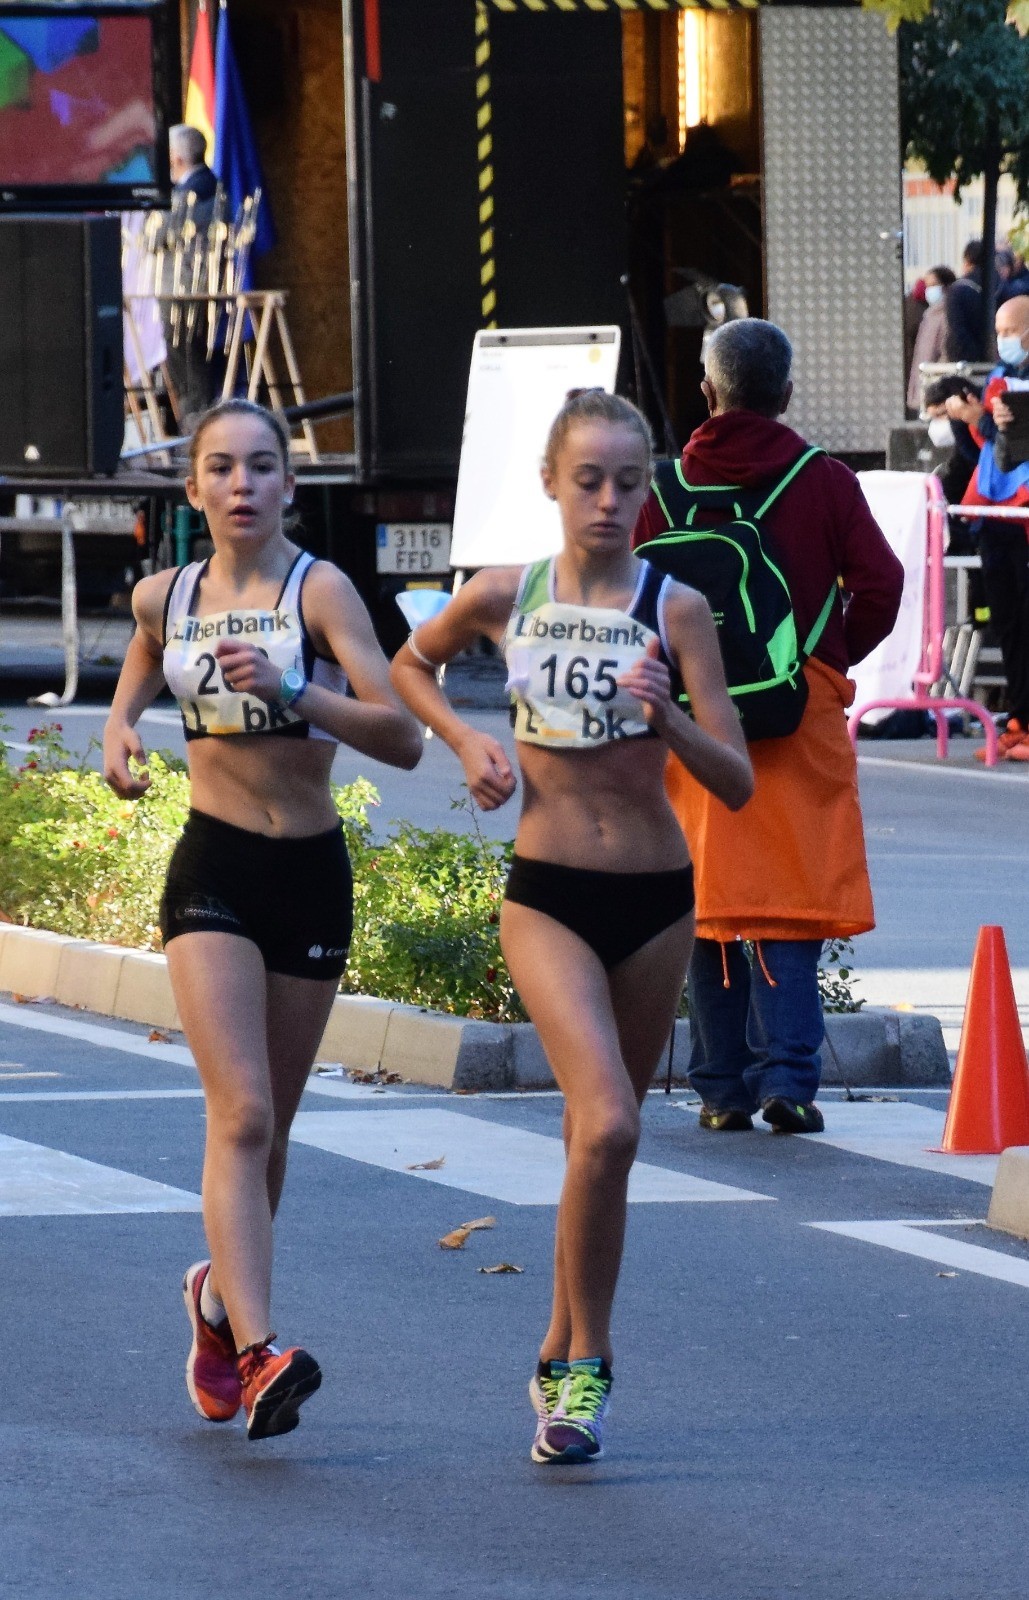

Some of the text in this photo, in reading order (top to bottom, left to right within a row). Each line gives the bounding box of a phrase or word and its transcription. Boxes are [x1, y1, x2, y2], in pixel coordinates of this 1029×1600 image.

[393, 529, 441, 548] 3116
[396, 550, 433, 569] FFD
[540, 653, 619, 703] 165
[581, 708, 629, 740] bk
